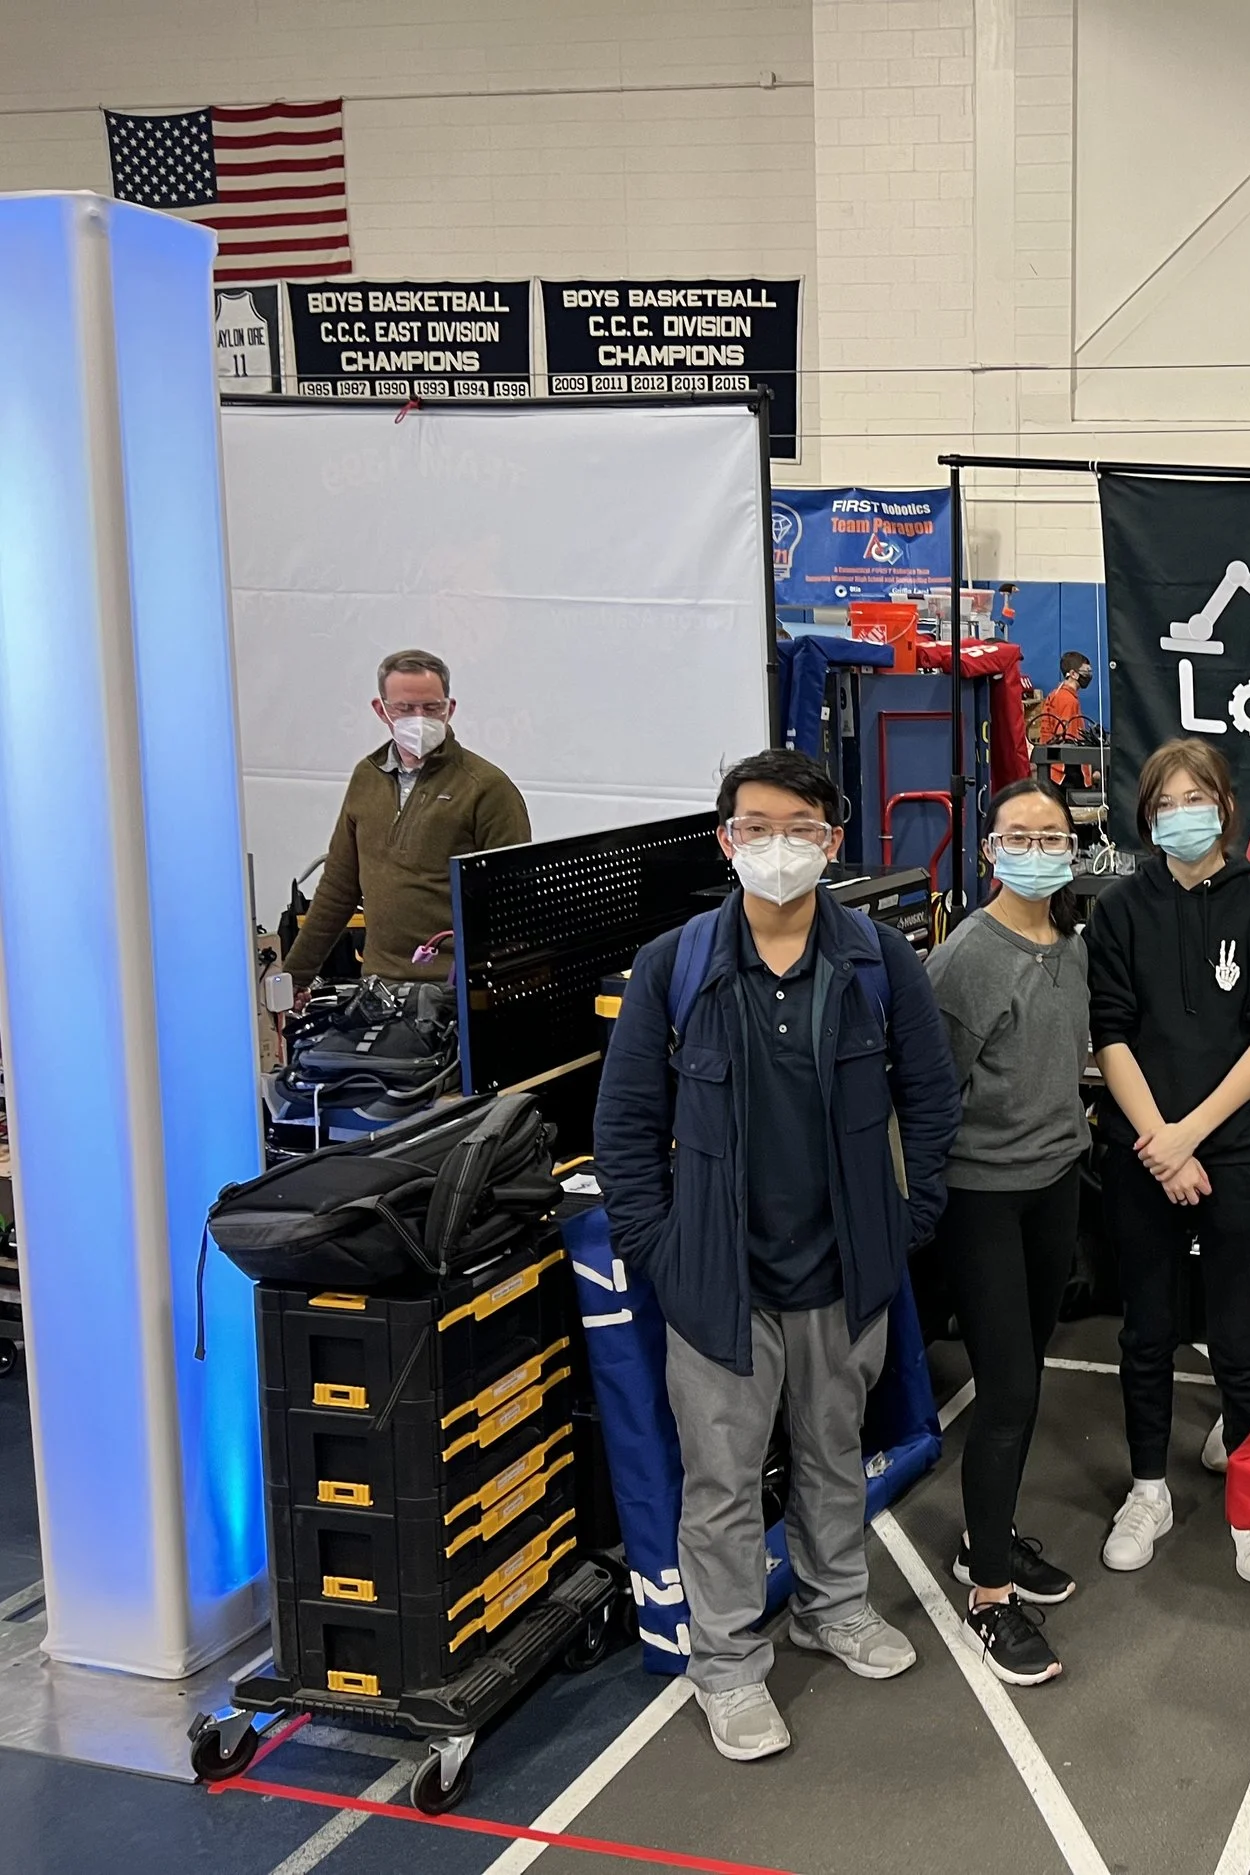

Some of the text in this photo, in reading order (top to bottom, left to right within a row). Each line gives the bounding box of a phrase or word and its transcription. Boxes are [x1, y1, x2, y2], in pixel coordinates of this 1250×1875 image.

[307, 291, 510, 313] BOYS BASKETBALL
[562, 288, 777, 308] BOYS BASKETBALL
[320, 321, 500, 343] C.C.C. EAST DIVISION
[588, 315, 751, 338] C.C.C. DIVISION
[233, 354, 248, 378] 11
[340, 350, 480, 372] CHAMPIONS
[598, 345, 745, 367] CHAMPIONS
[302, 382, 526, 397] 1985 1987 1990 1993 1994 1998
[554, 377, 746, 391] 2009 2011 2012 2013 2015
[832, 500, 931, 516] FIRST Robotics
[831, 517, 934, 537] Team Paragon
